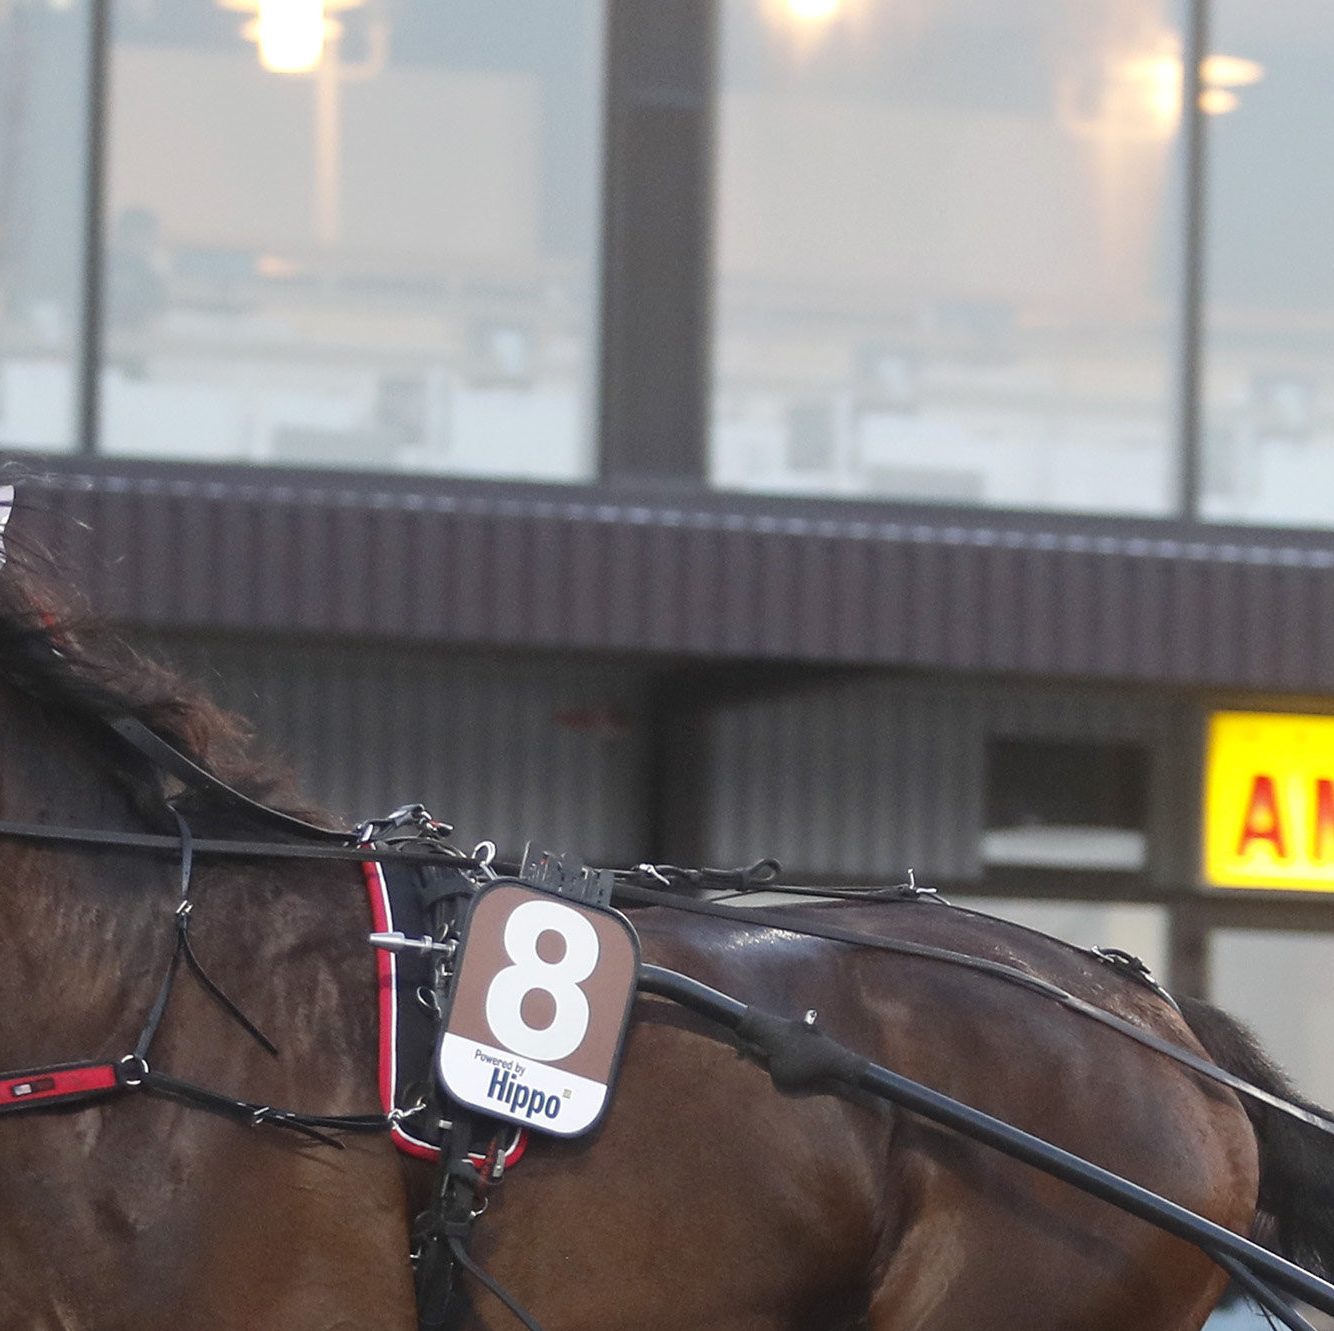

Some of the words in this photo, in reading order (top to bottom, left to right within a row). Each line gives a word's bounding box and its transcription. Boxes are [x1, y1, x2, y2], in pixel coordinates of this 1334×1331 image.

[485, 899, 600, 1062] 8
[474, 1048, 514, 1071] Powered
[514, 1062, 527, 1077] by
[487, 1066, 562, 1119] Hippo
